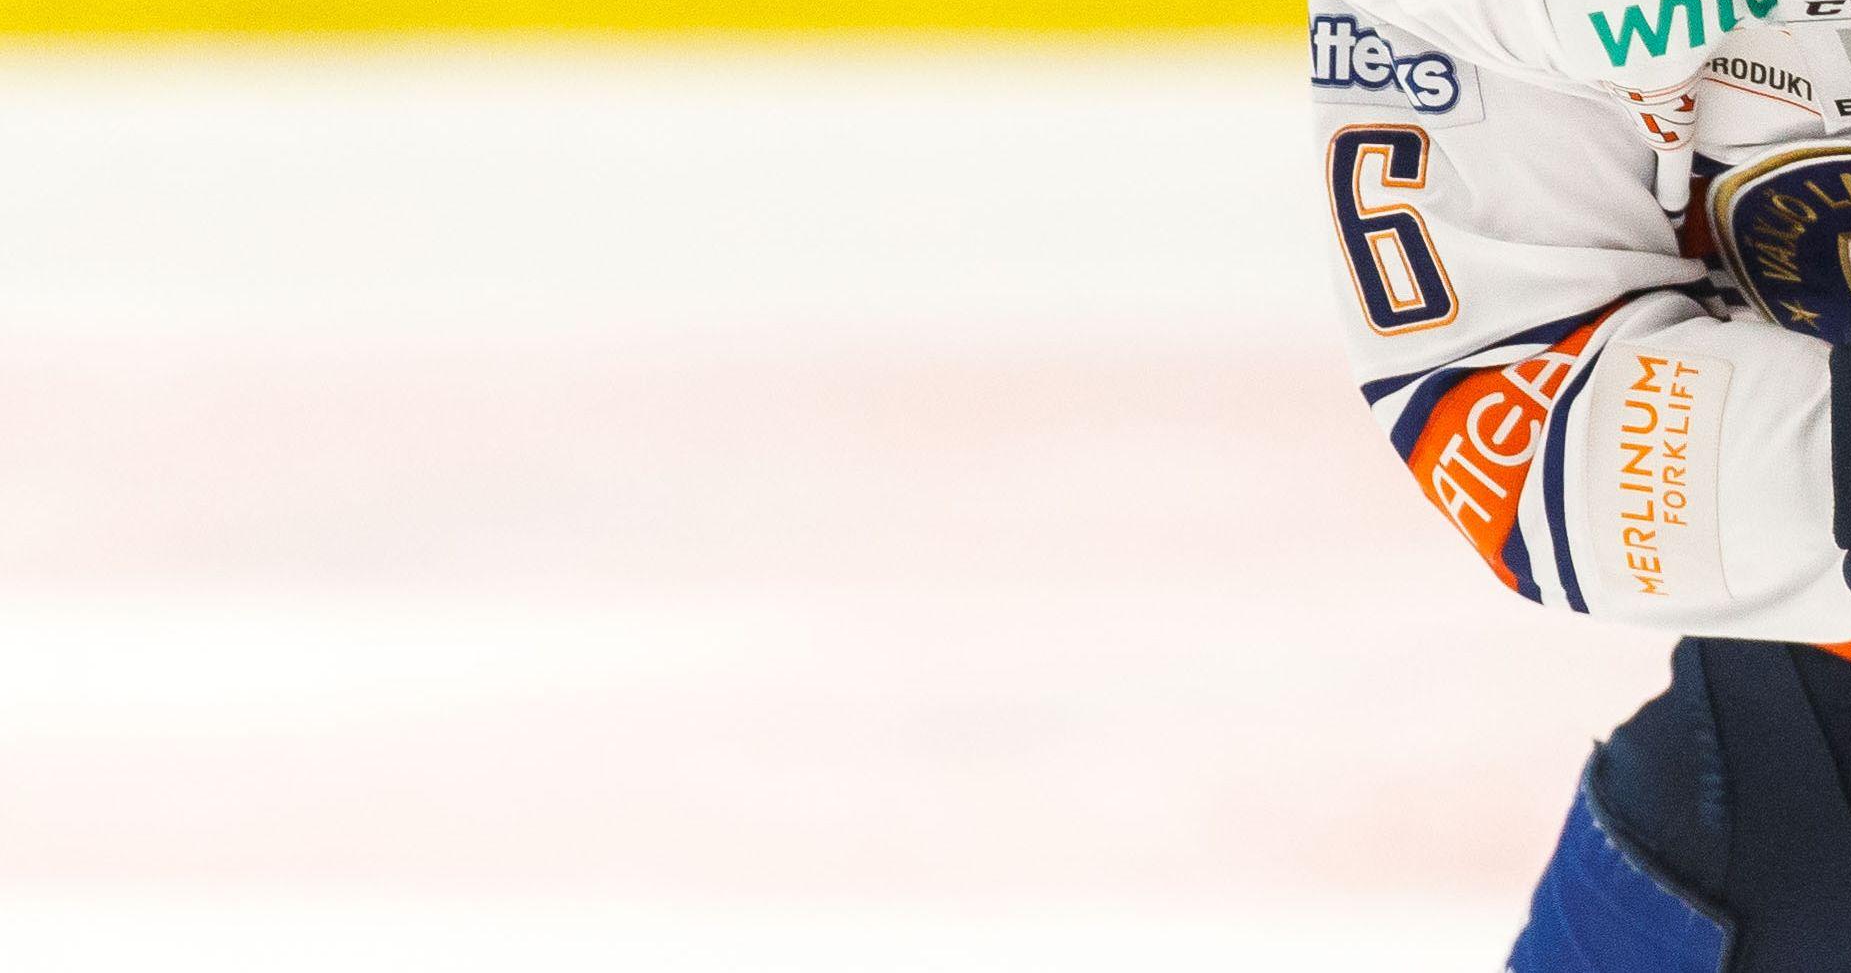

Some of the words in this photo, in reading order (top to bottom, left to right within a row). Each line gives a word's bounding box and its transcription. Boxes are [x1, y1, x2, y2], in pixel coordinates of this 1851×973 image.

[1704, 57, 1812, 102] RODUKT
[1326, 123, 1459, 337] 6
[1619, 355, 1669, 596] MERLINUM
[1662, 364, 1699, 526] FORKLIFT
